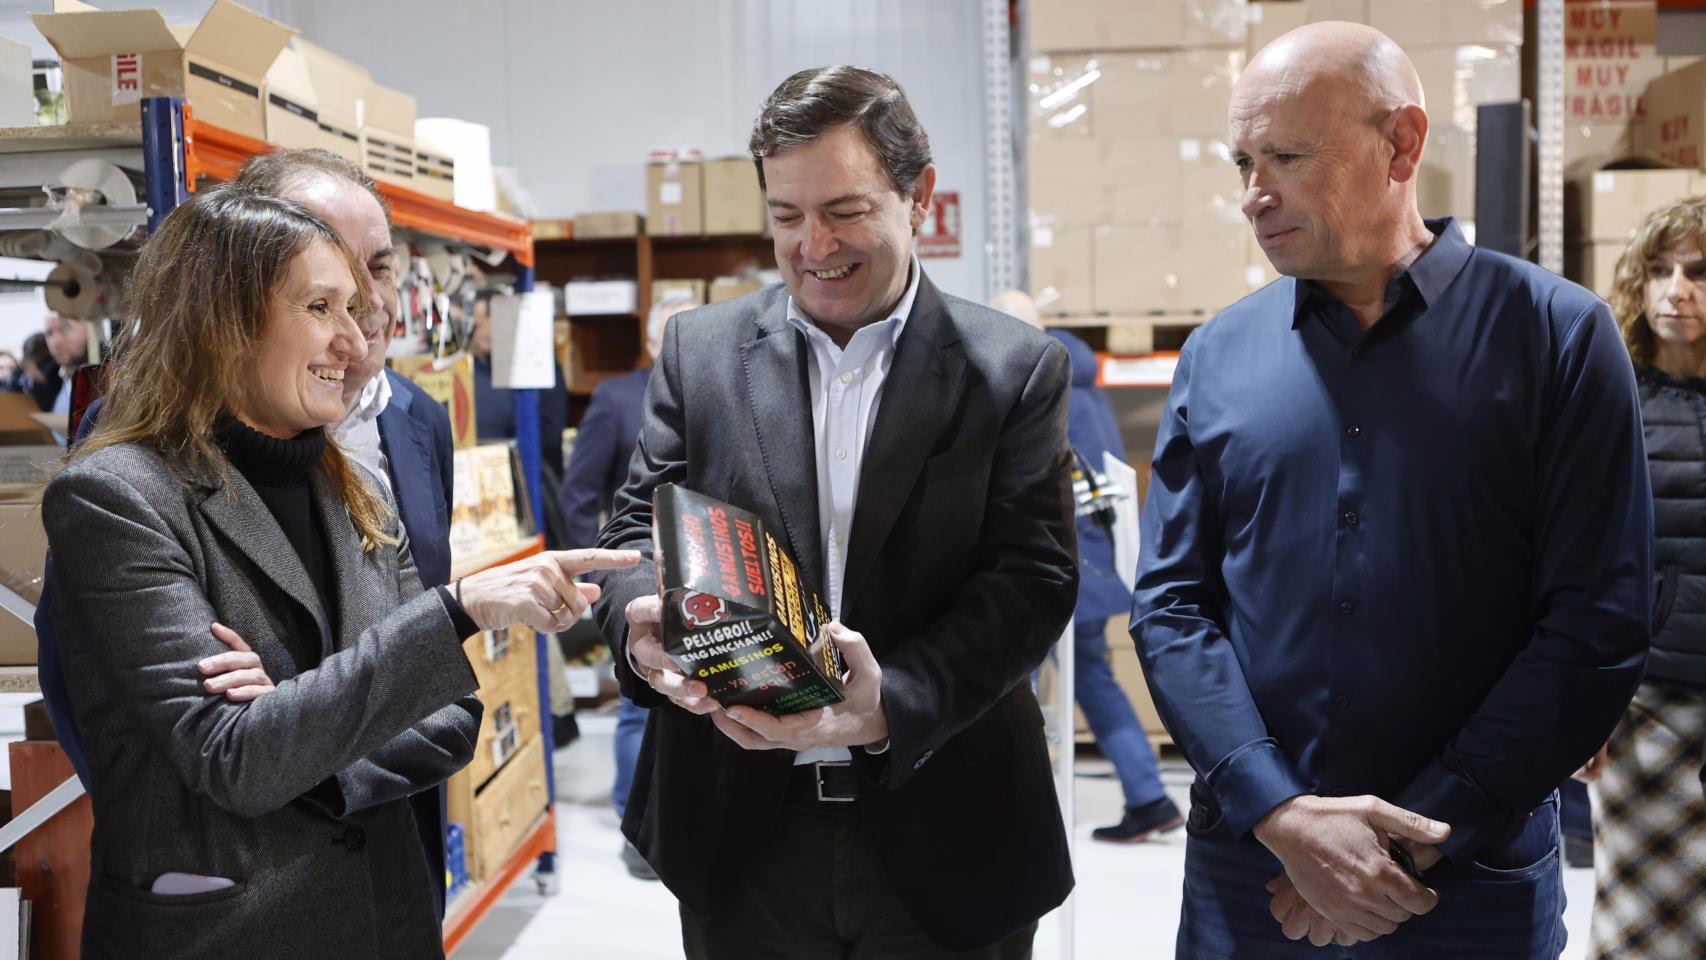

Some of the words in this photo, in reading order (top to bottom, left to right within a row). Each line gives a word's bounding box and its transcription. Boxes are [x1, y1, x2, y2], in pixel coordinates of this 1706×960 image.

[1566, 37, 1640, 59] RAGIL
[1577, 65, 1629, 87] MUY
[1567, 93, 1648, 117] RAGIL
[708, 506, 742, 596] GAMUSINOS
[680, 630, 774, 663] ENGANCHAN!!
